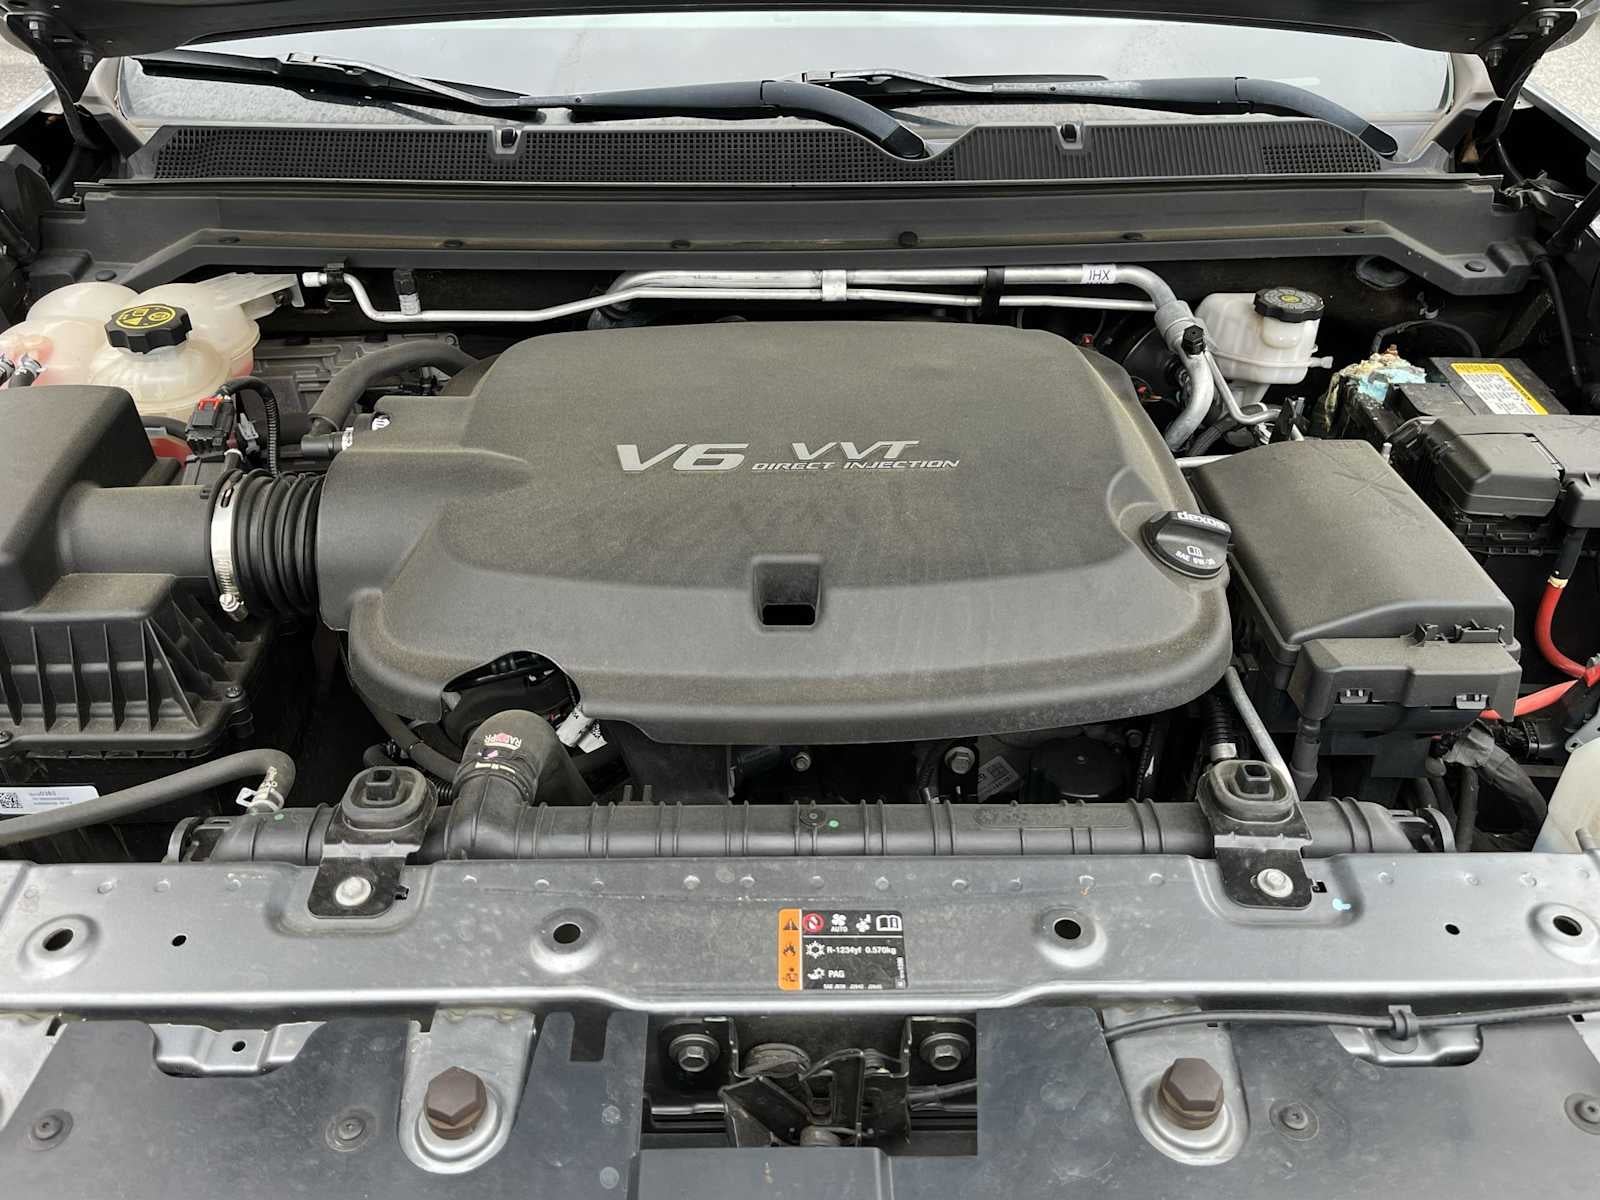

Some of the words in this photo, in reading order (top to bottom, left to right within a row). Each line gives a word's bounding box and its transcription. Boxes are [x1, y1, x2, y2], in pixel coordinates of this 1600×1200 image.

[616, 443, 749, 471] V6
[791, 440, 920, 460] VVT
[751, 461, 836, 471] DIRECT
[843, 459, 961, 470] INJECTION
[828, 970, 845, 978] PAG
